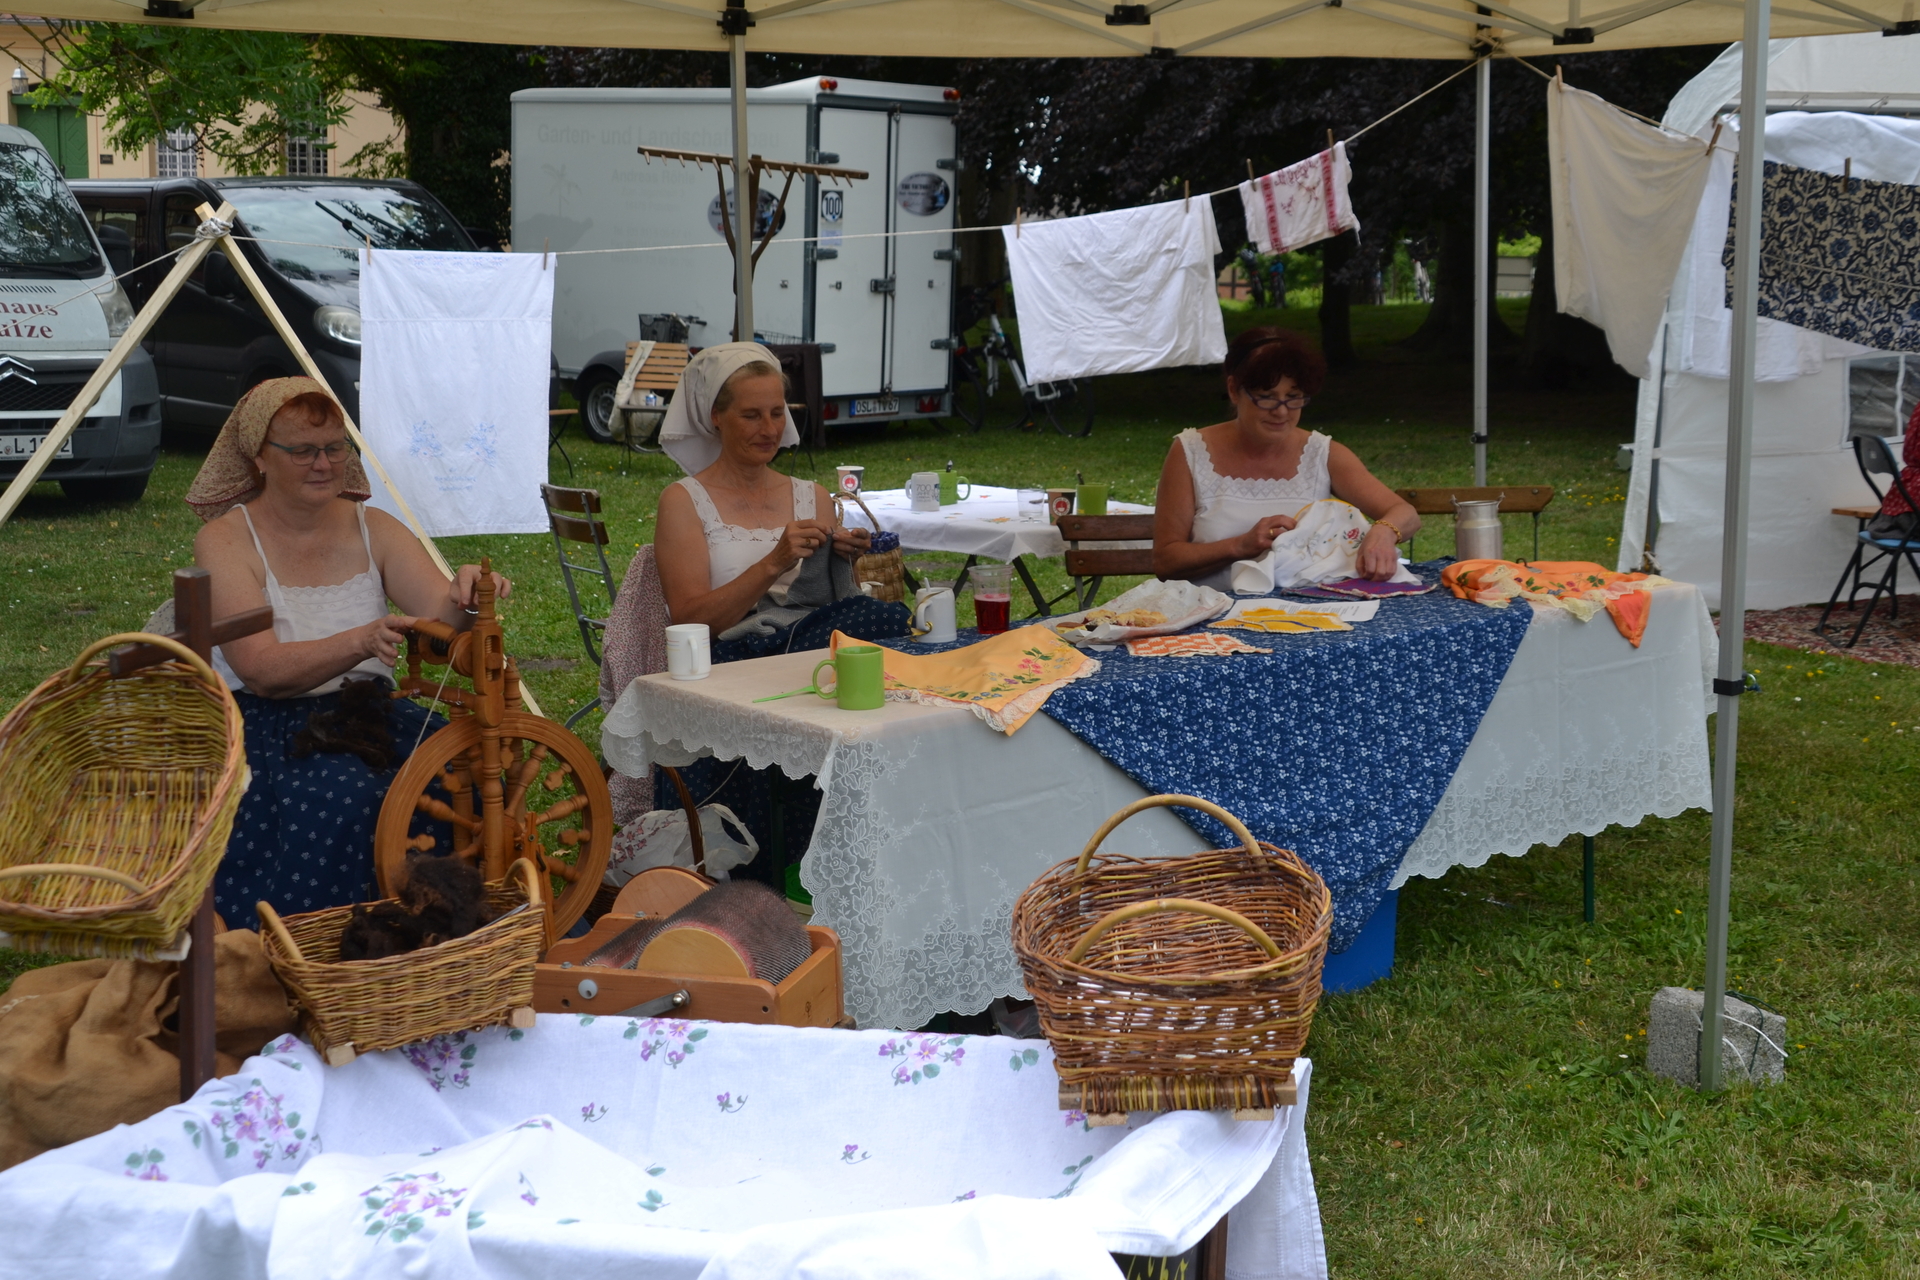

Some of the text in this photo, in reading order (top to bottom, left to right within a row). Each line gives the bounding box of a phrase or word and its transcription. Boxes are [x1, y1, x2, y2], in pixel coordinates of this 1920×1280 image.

[537, 123, 780, 148] Garten- und Landschafbau
[610, 168, 660, 184] Andreas
[825, 197, 840, 215] 100
[856, 401, 871, 413] OSL
[915, 483, 931, 492] 700
